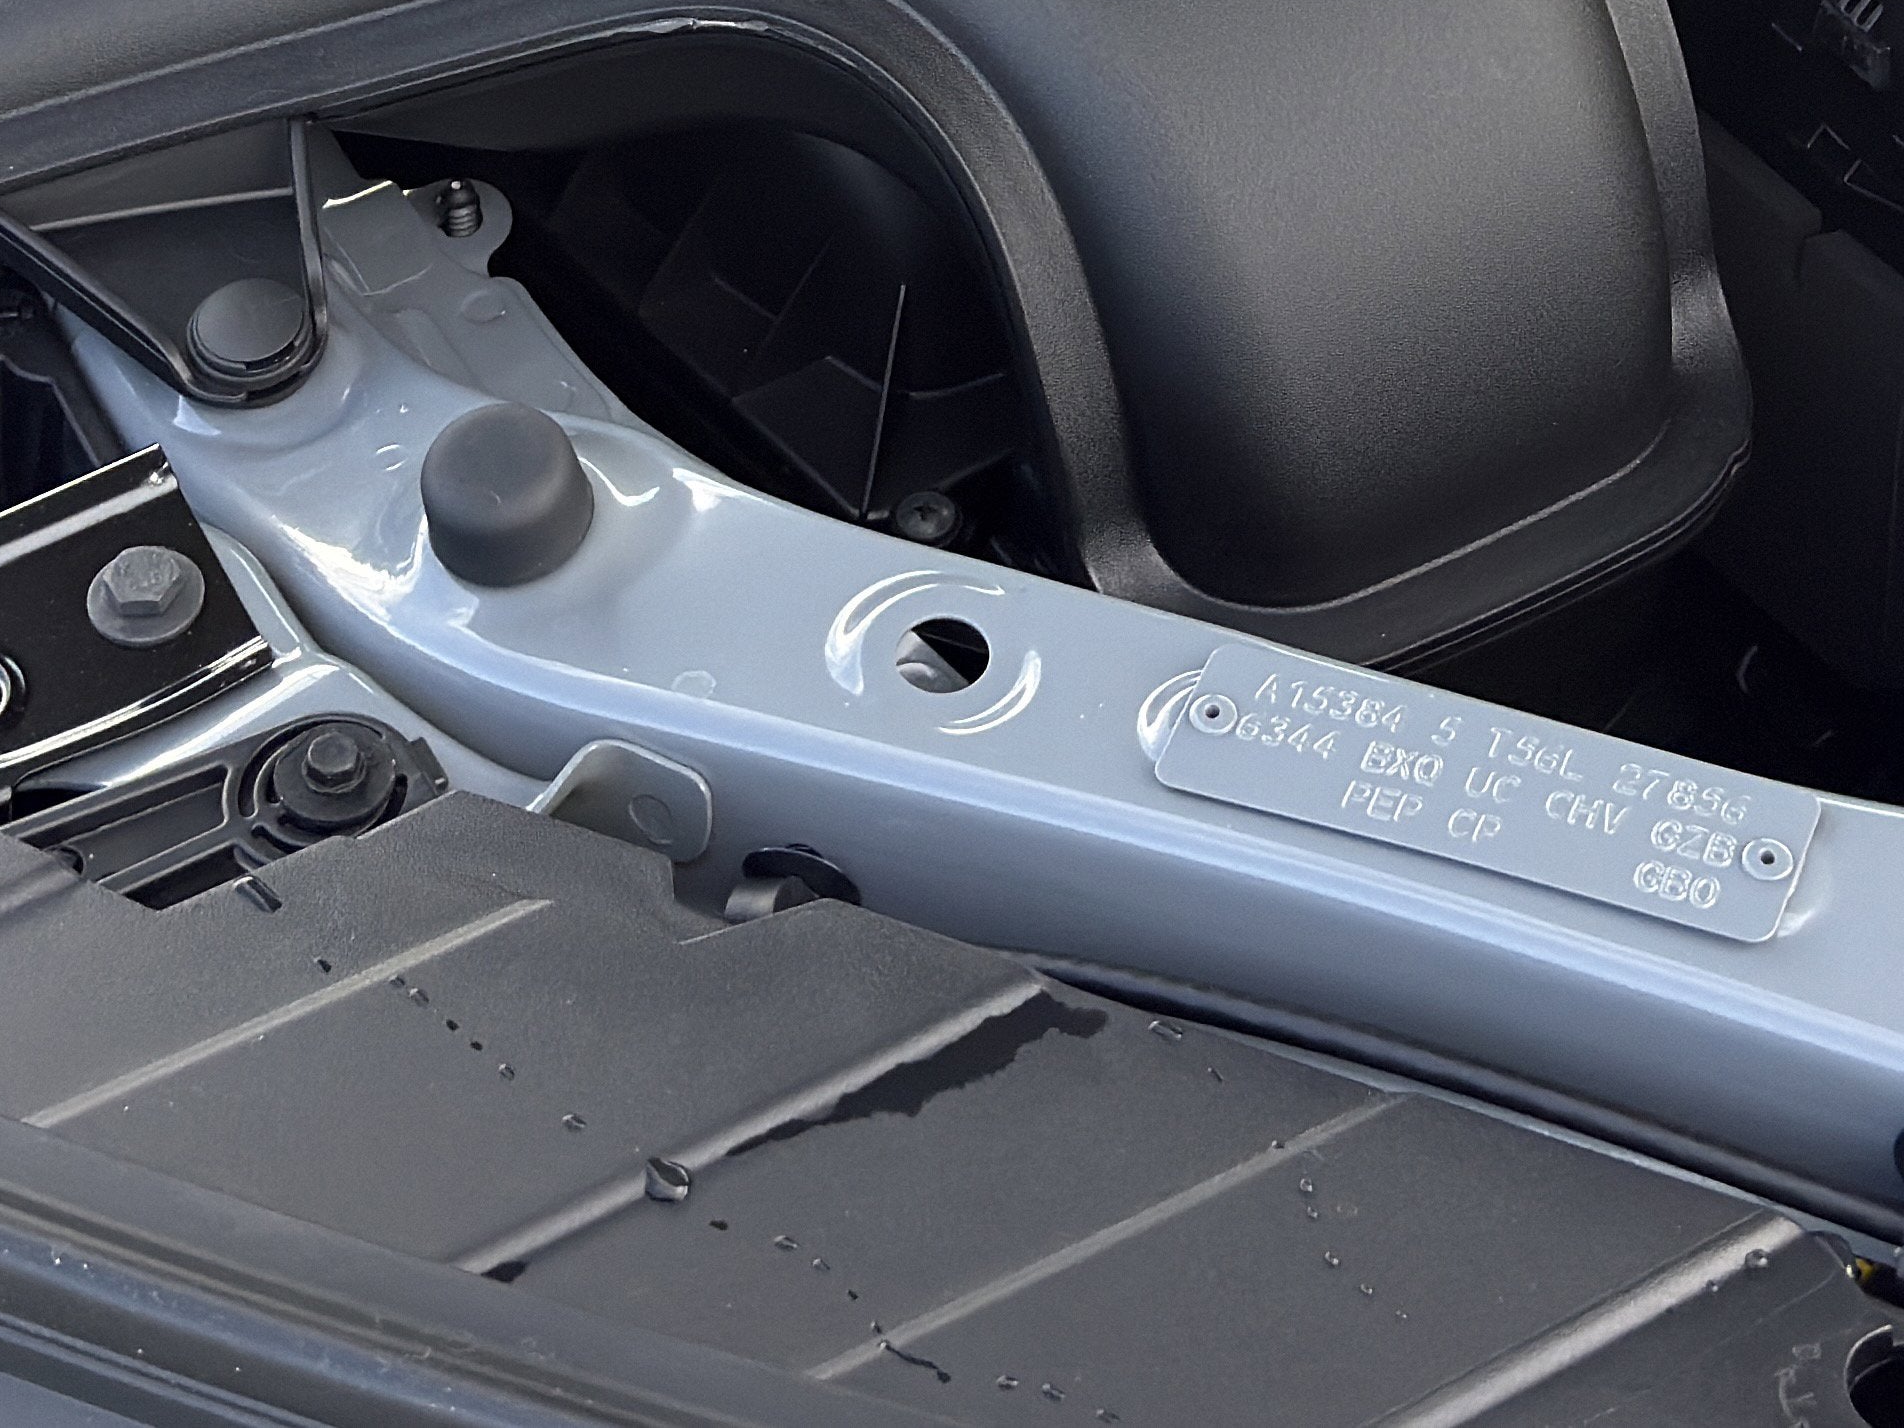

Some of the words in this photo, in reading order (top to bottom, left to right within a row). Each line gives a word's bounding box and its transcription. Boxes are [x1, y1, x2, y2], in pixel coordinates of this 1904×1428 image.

[1254, 673, 1408, 734] A15384
[1235, 712, 1341, 760] 6344
[1464, 766, 1523, 805] UC
[1545, 790, 1633, 836] CHV
[1341, 779, 1424, 823] PEP
[1448, 807, 1503, 844] CP
